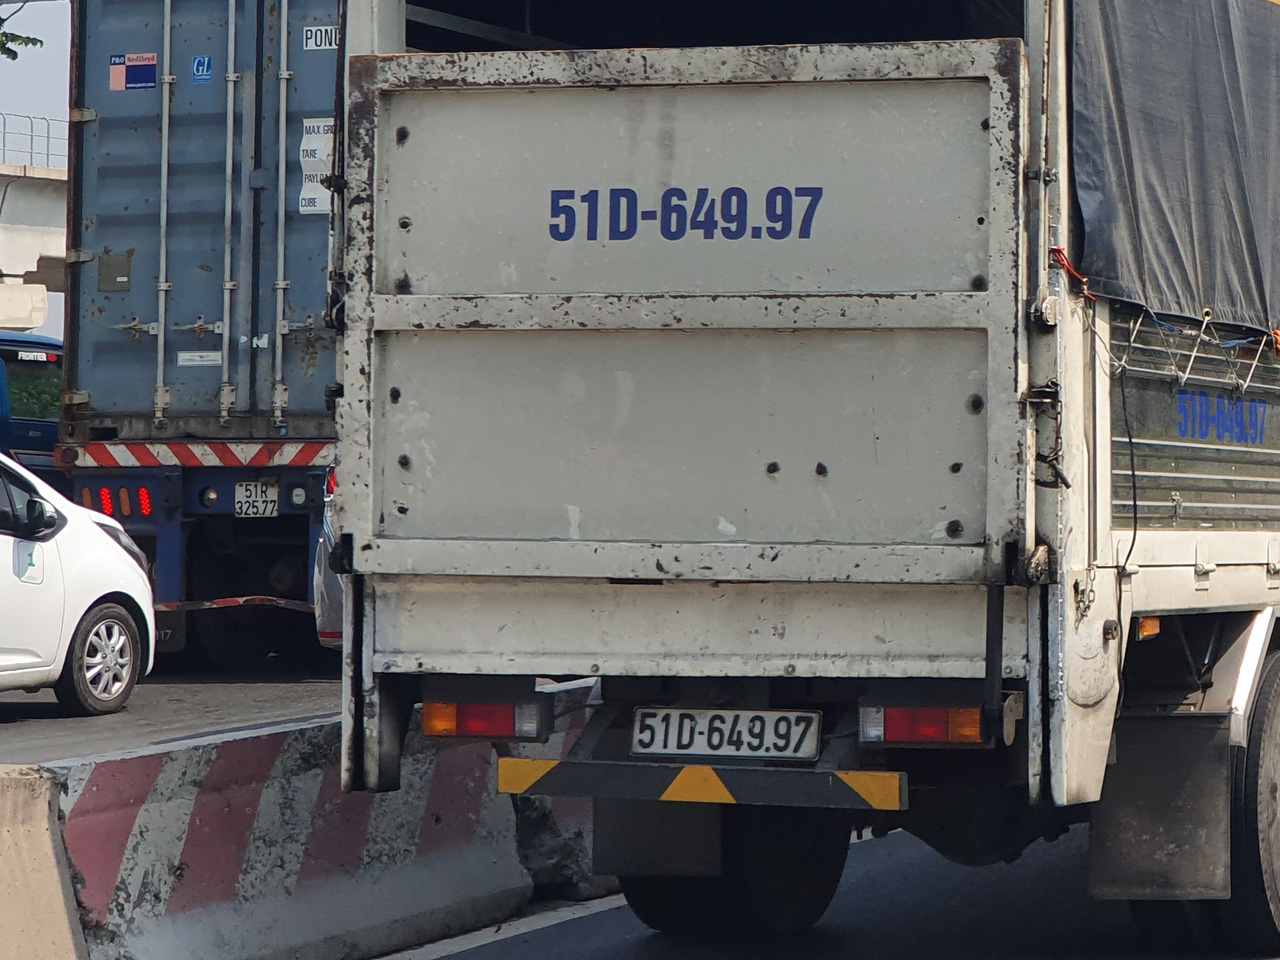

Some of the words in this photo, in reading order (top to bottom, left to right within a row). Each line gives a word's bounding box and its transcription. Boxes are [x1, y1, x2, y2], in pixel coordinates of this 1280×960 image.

[193, 57, 211, 75] GL
[302, 149, 317, 159] TARE
[300, 198, 317, 208] CUBE
[549, 186, 824, 242] 51D-649.97
[18, 351, 47, 361] FRONTIER
[1177, 389, 1268, 446] 51D-649.97
[244, 483, 268, 499] 51R
[236, 500, 277, 516] 325.77
[637, 712, 815, 754] 51D-649.97
